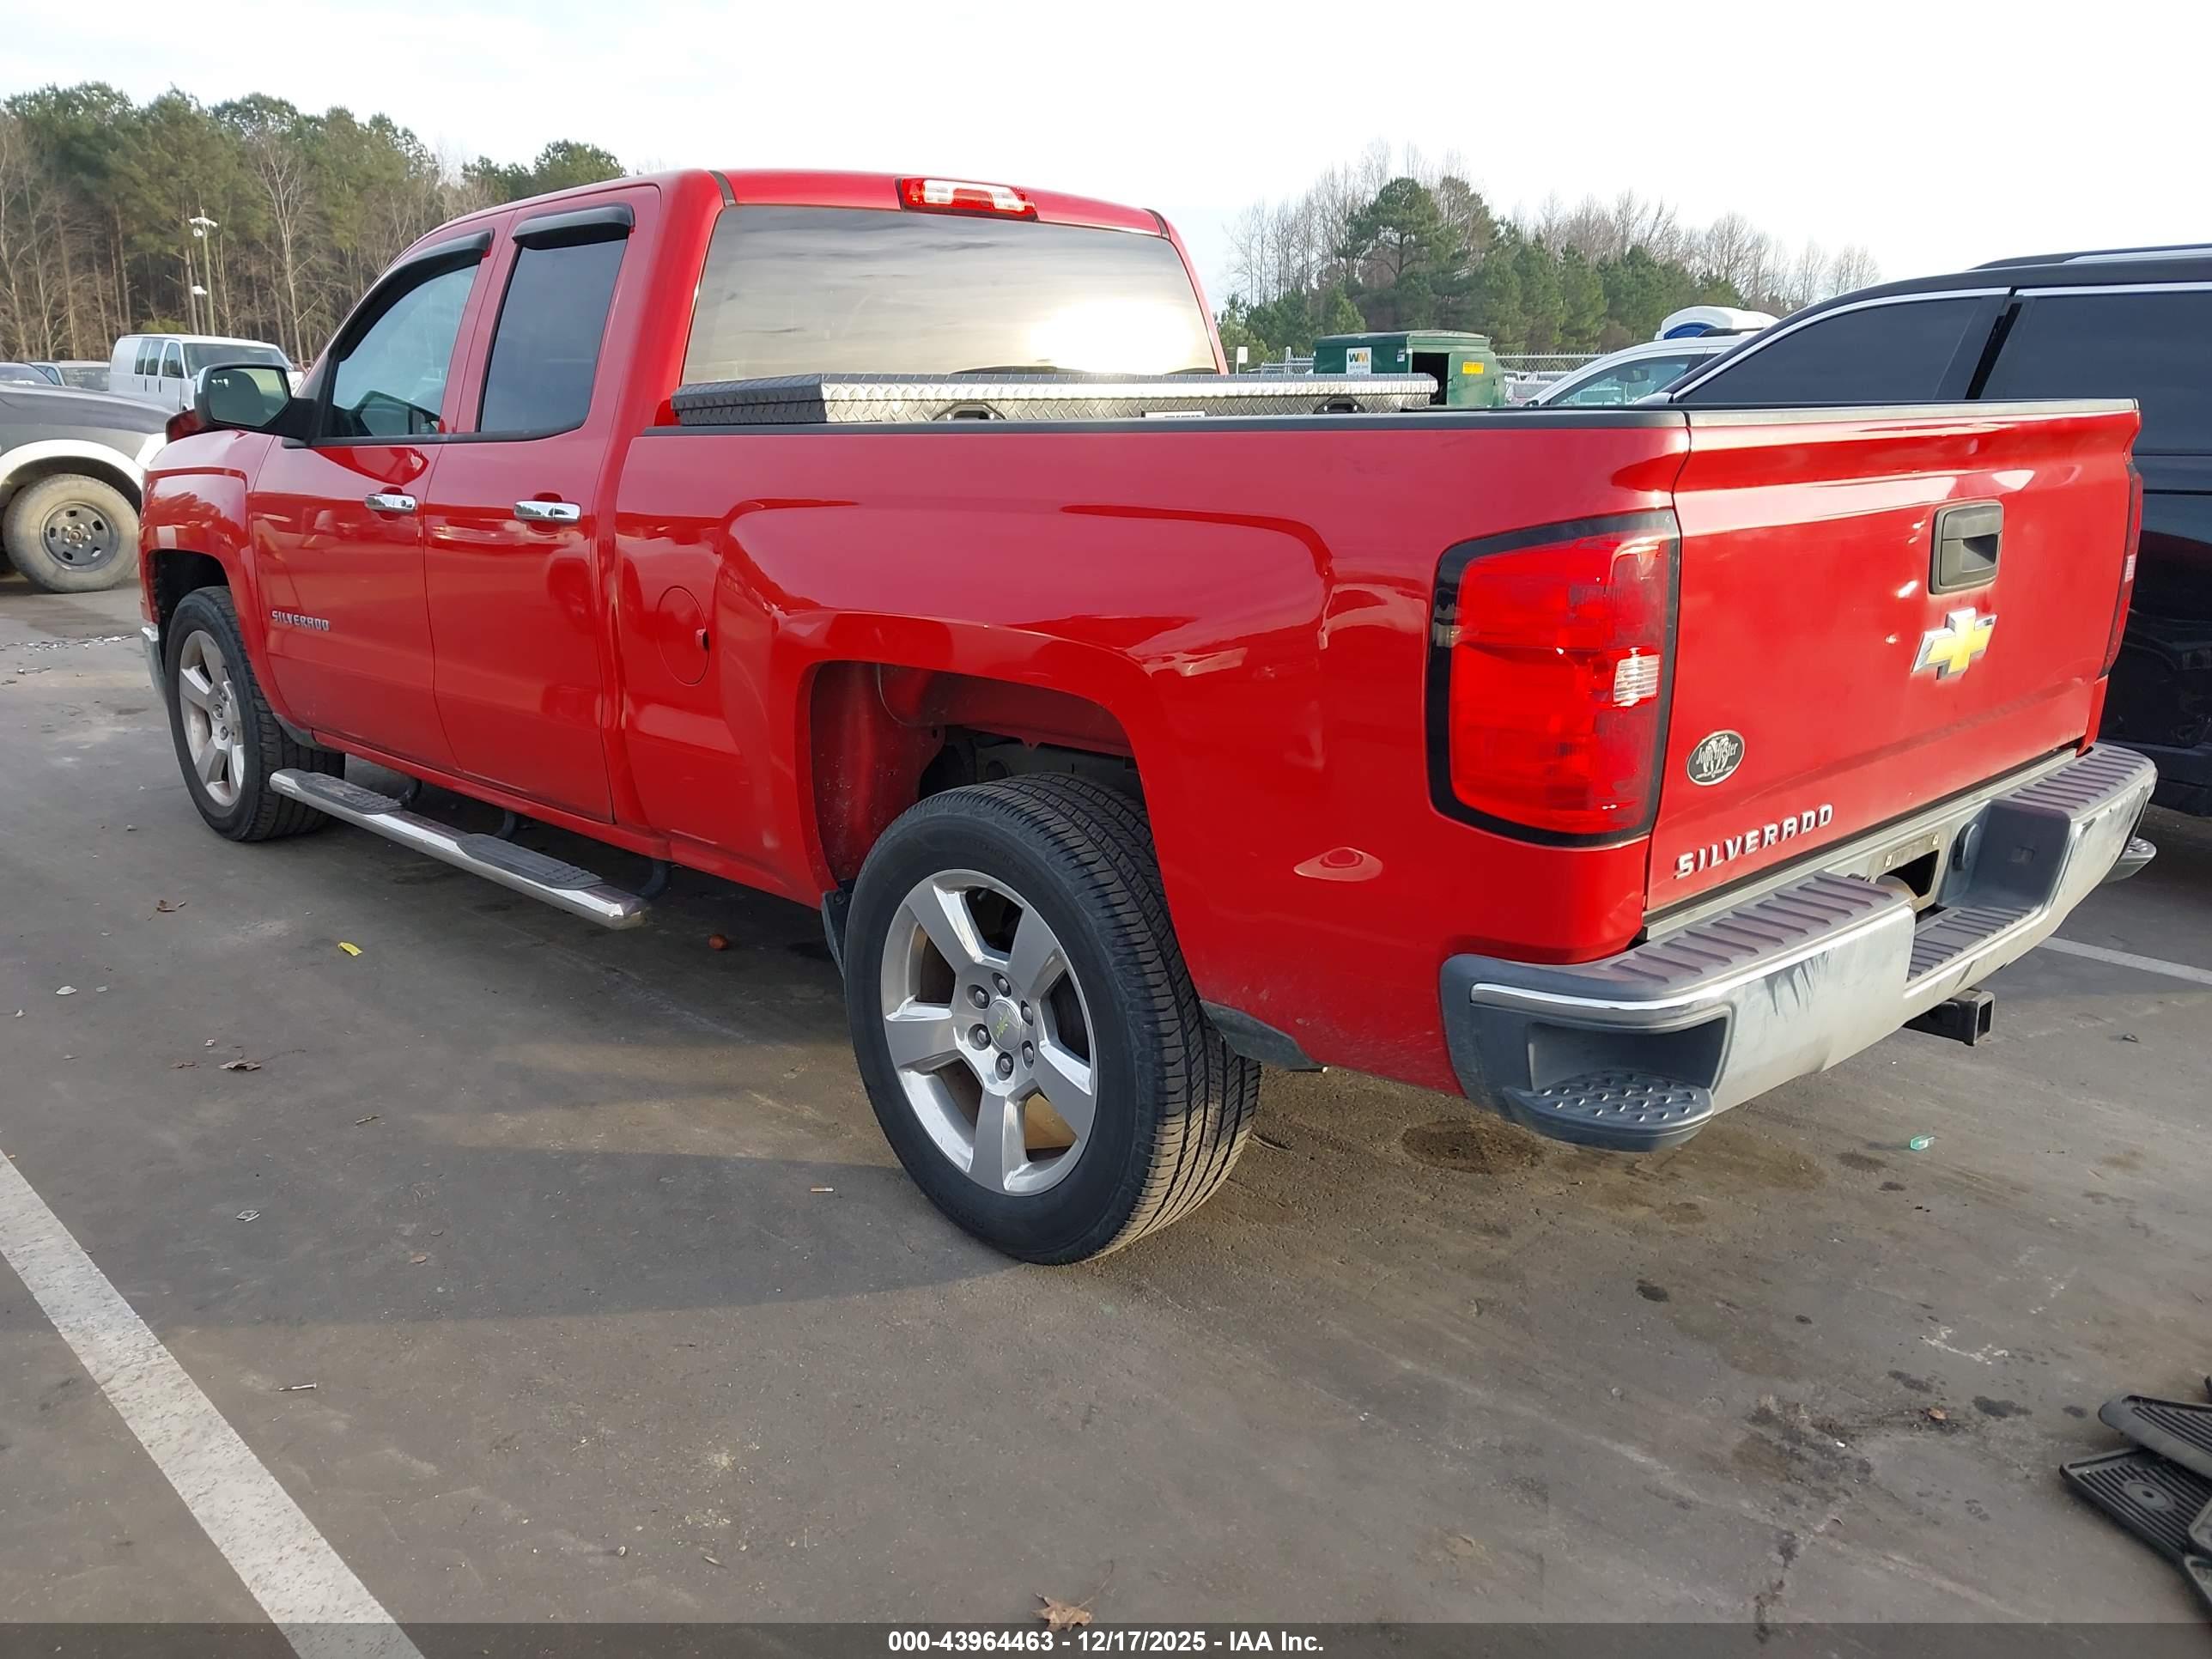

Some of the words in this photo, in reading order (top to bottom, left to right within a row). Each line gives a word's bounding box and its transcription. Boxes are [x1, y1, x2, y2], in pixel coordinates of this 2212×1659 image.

[1348, 352, 1369, 363] WM
[271, 610, 330, 631] SILVERADO
[1674, 803, 1833, 879] SILVERADO
